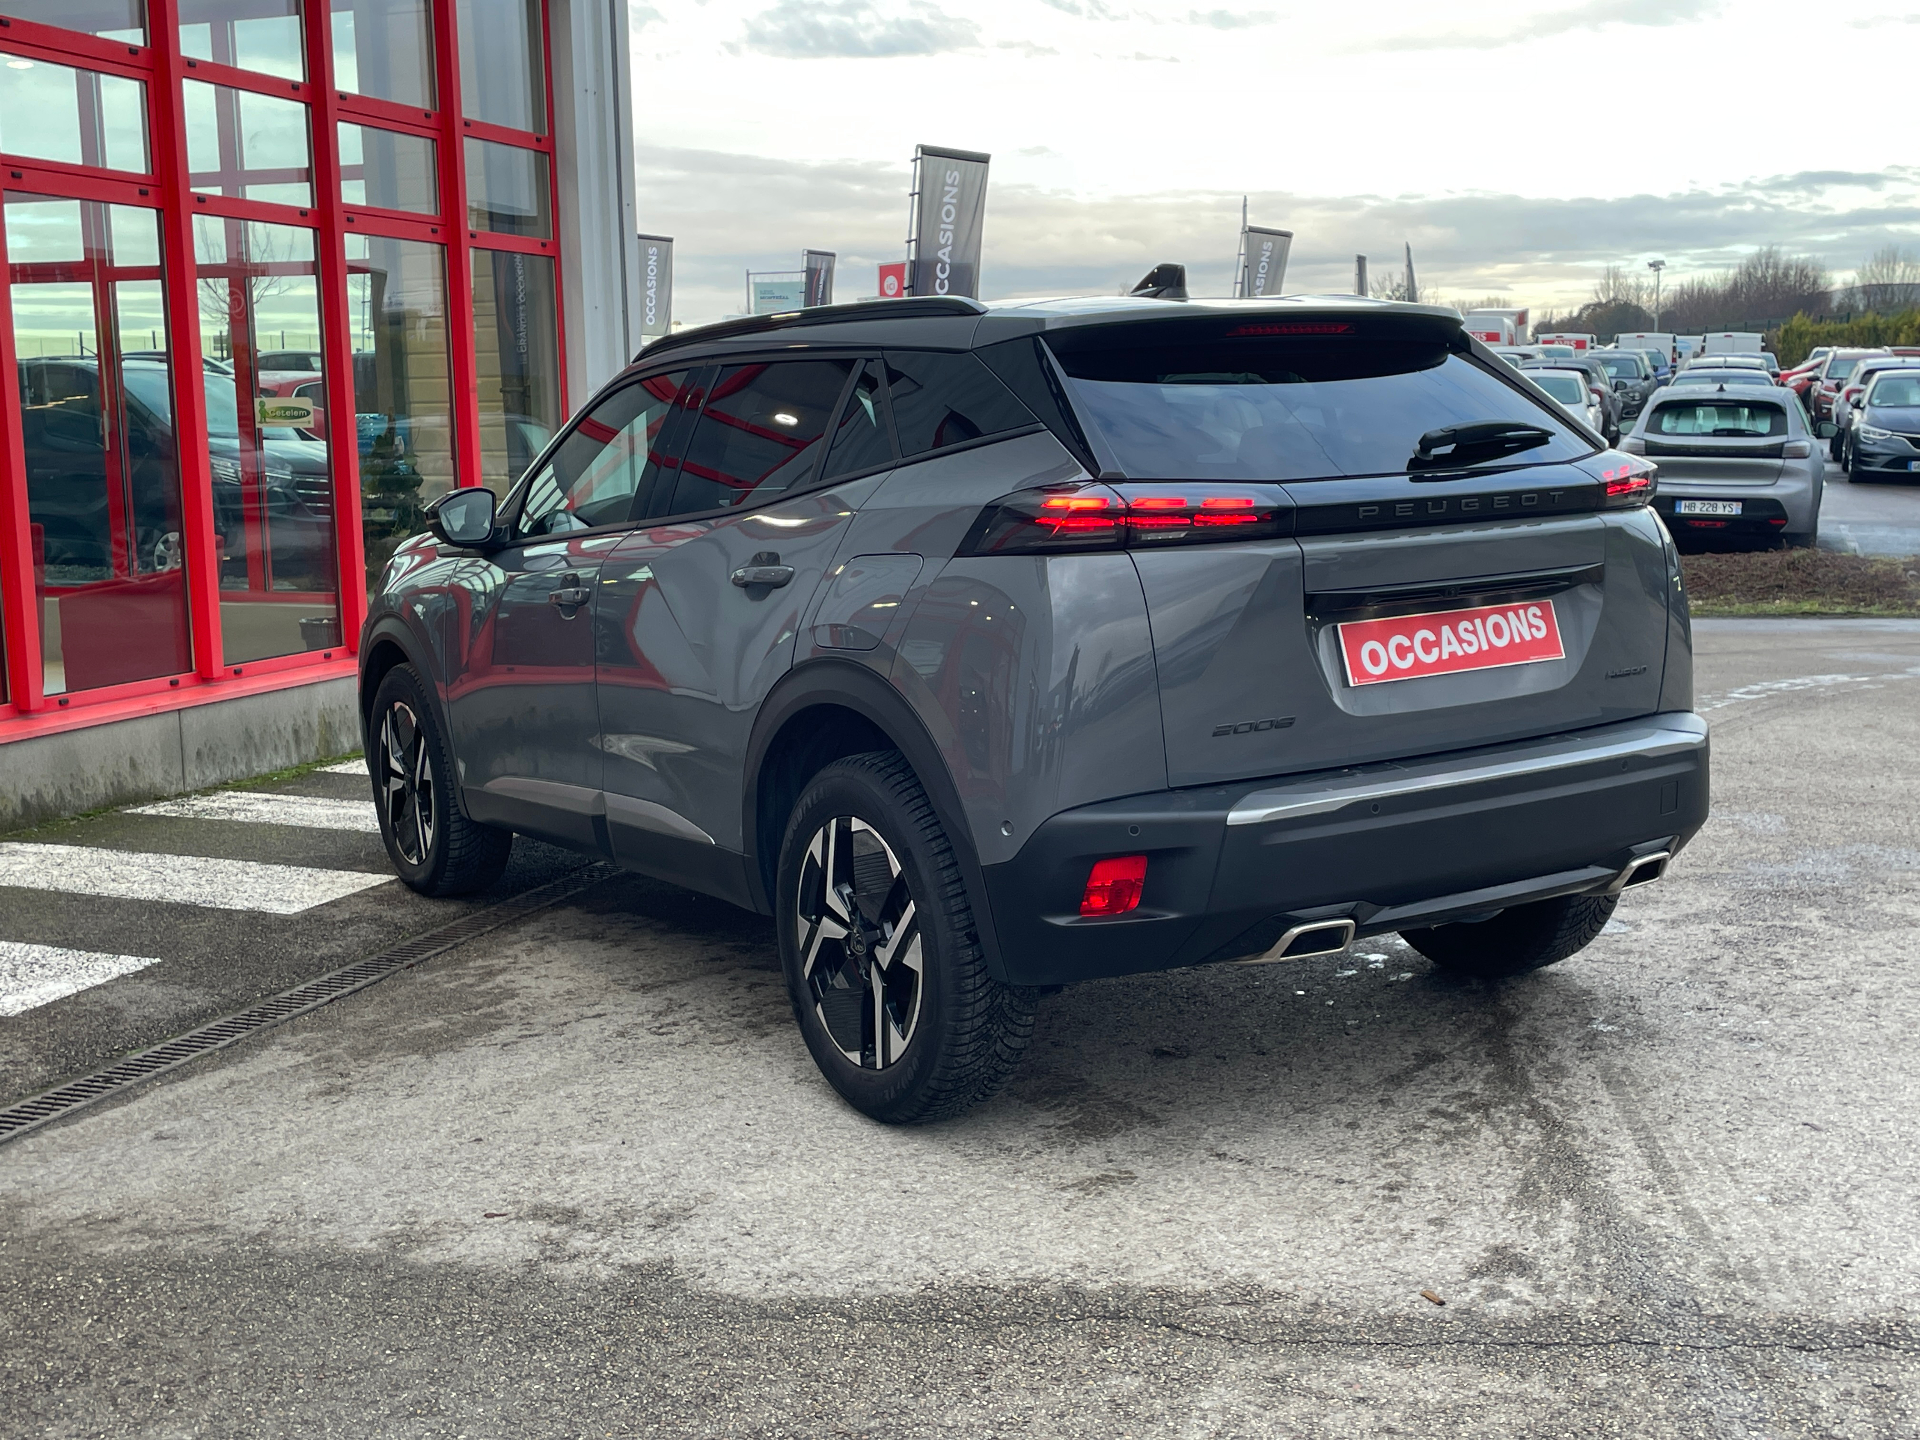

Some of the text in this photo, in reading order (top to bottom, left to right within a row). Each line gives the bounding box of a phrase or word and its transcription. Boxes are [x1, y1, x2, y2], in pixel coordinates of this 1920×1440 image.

[935, 169, 961, 296] CCASIONS
[514, 253, 527, 302] OCCASION
[645, 246, 658, 326] OCCASIONS
[1254, 241, 1273, 296] ASIONS
[1358, 491, 1565, 519] PEUGEOT
[1683, 502, 1735, 513] HB 228 YS
[1360, 605, 1548, 676] OCCASIONS
[1211, 714, 1297, 738] 2008
